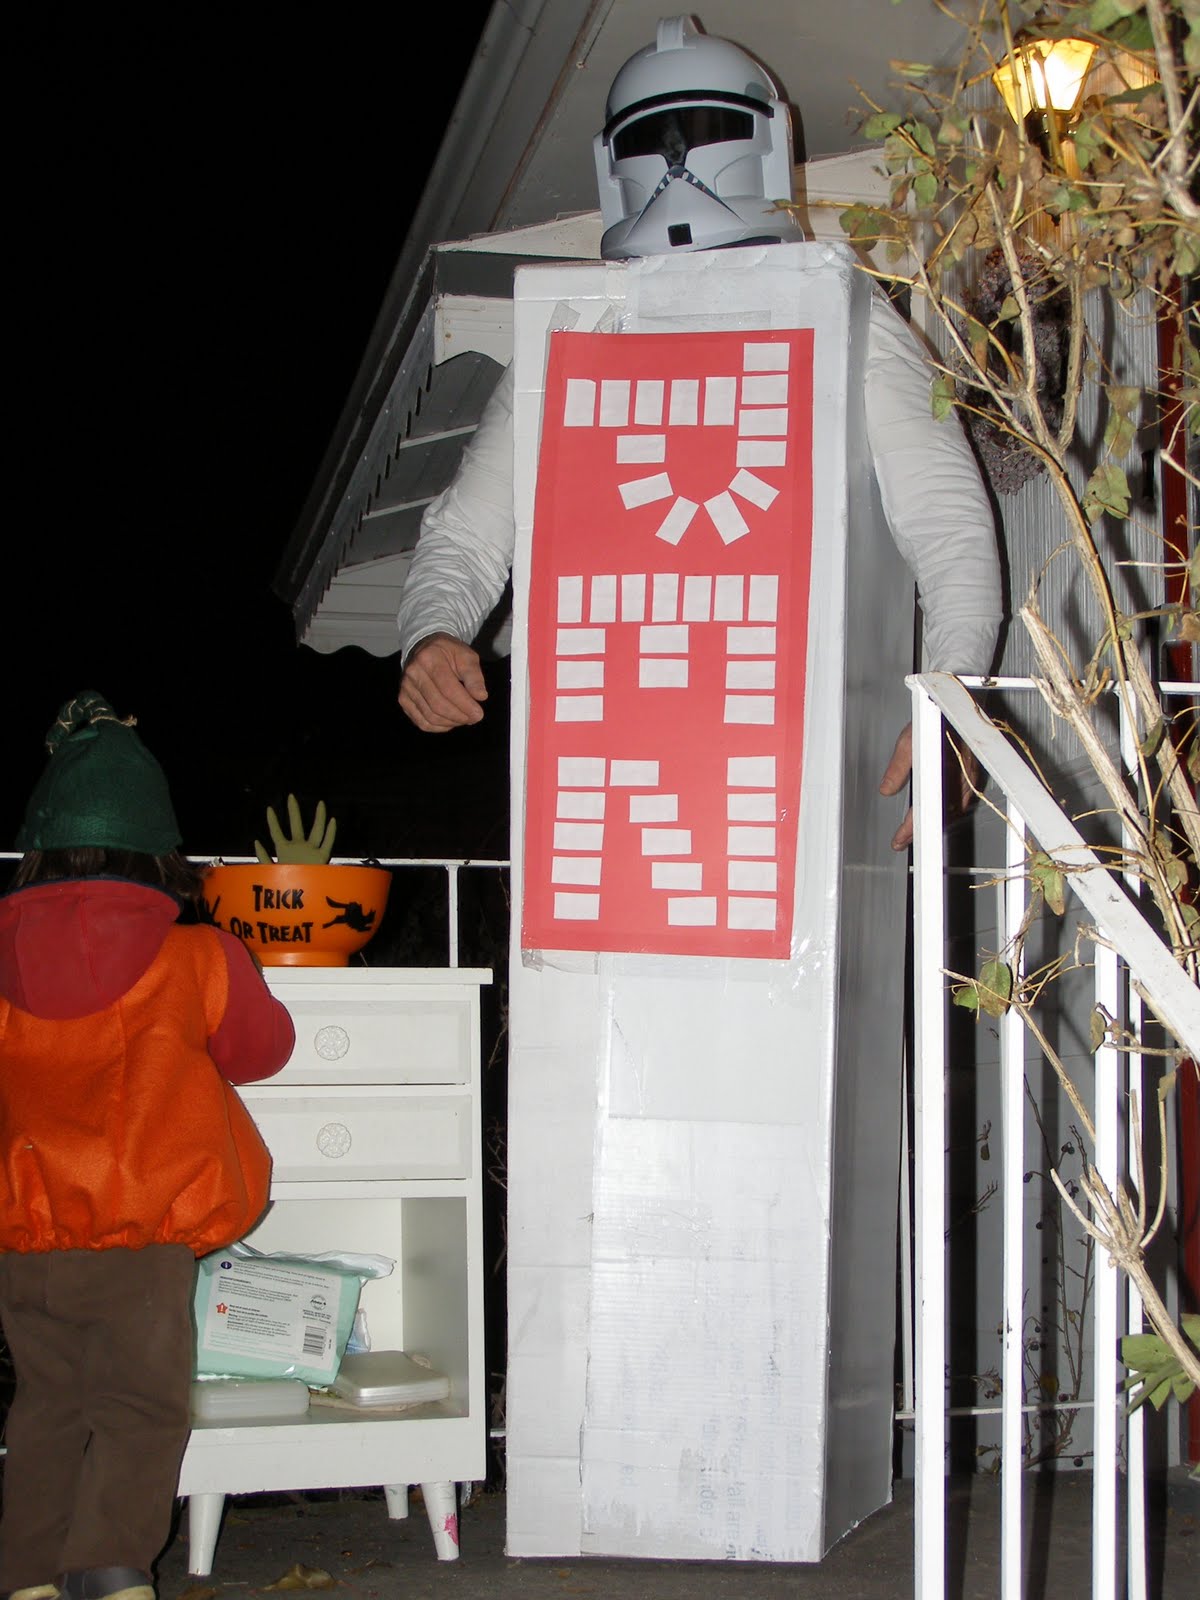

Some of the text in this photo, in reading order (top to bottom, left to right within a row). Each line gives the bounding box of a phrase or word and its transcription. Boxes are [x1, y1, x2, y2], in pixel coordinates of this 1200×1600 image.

[252, 884, 304, 912] TRICK
[230, 916, 314, 944] OR TREAT
